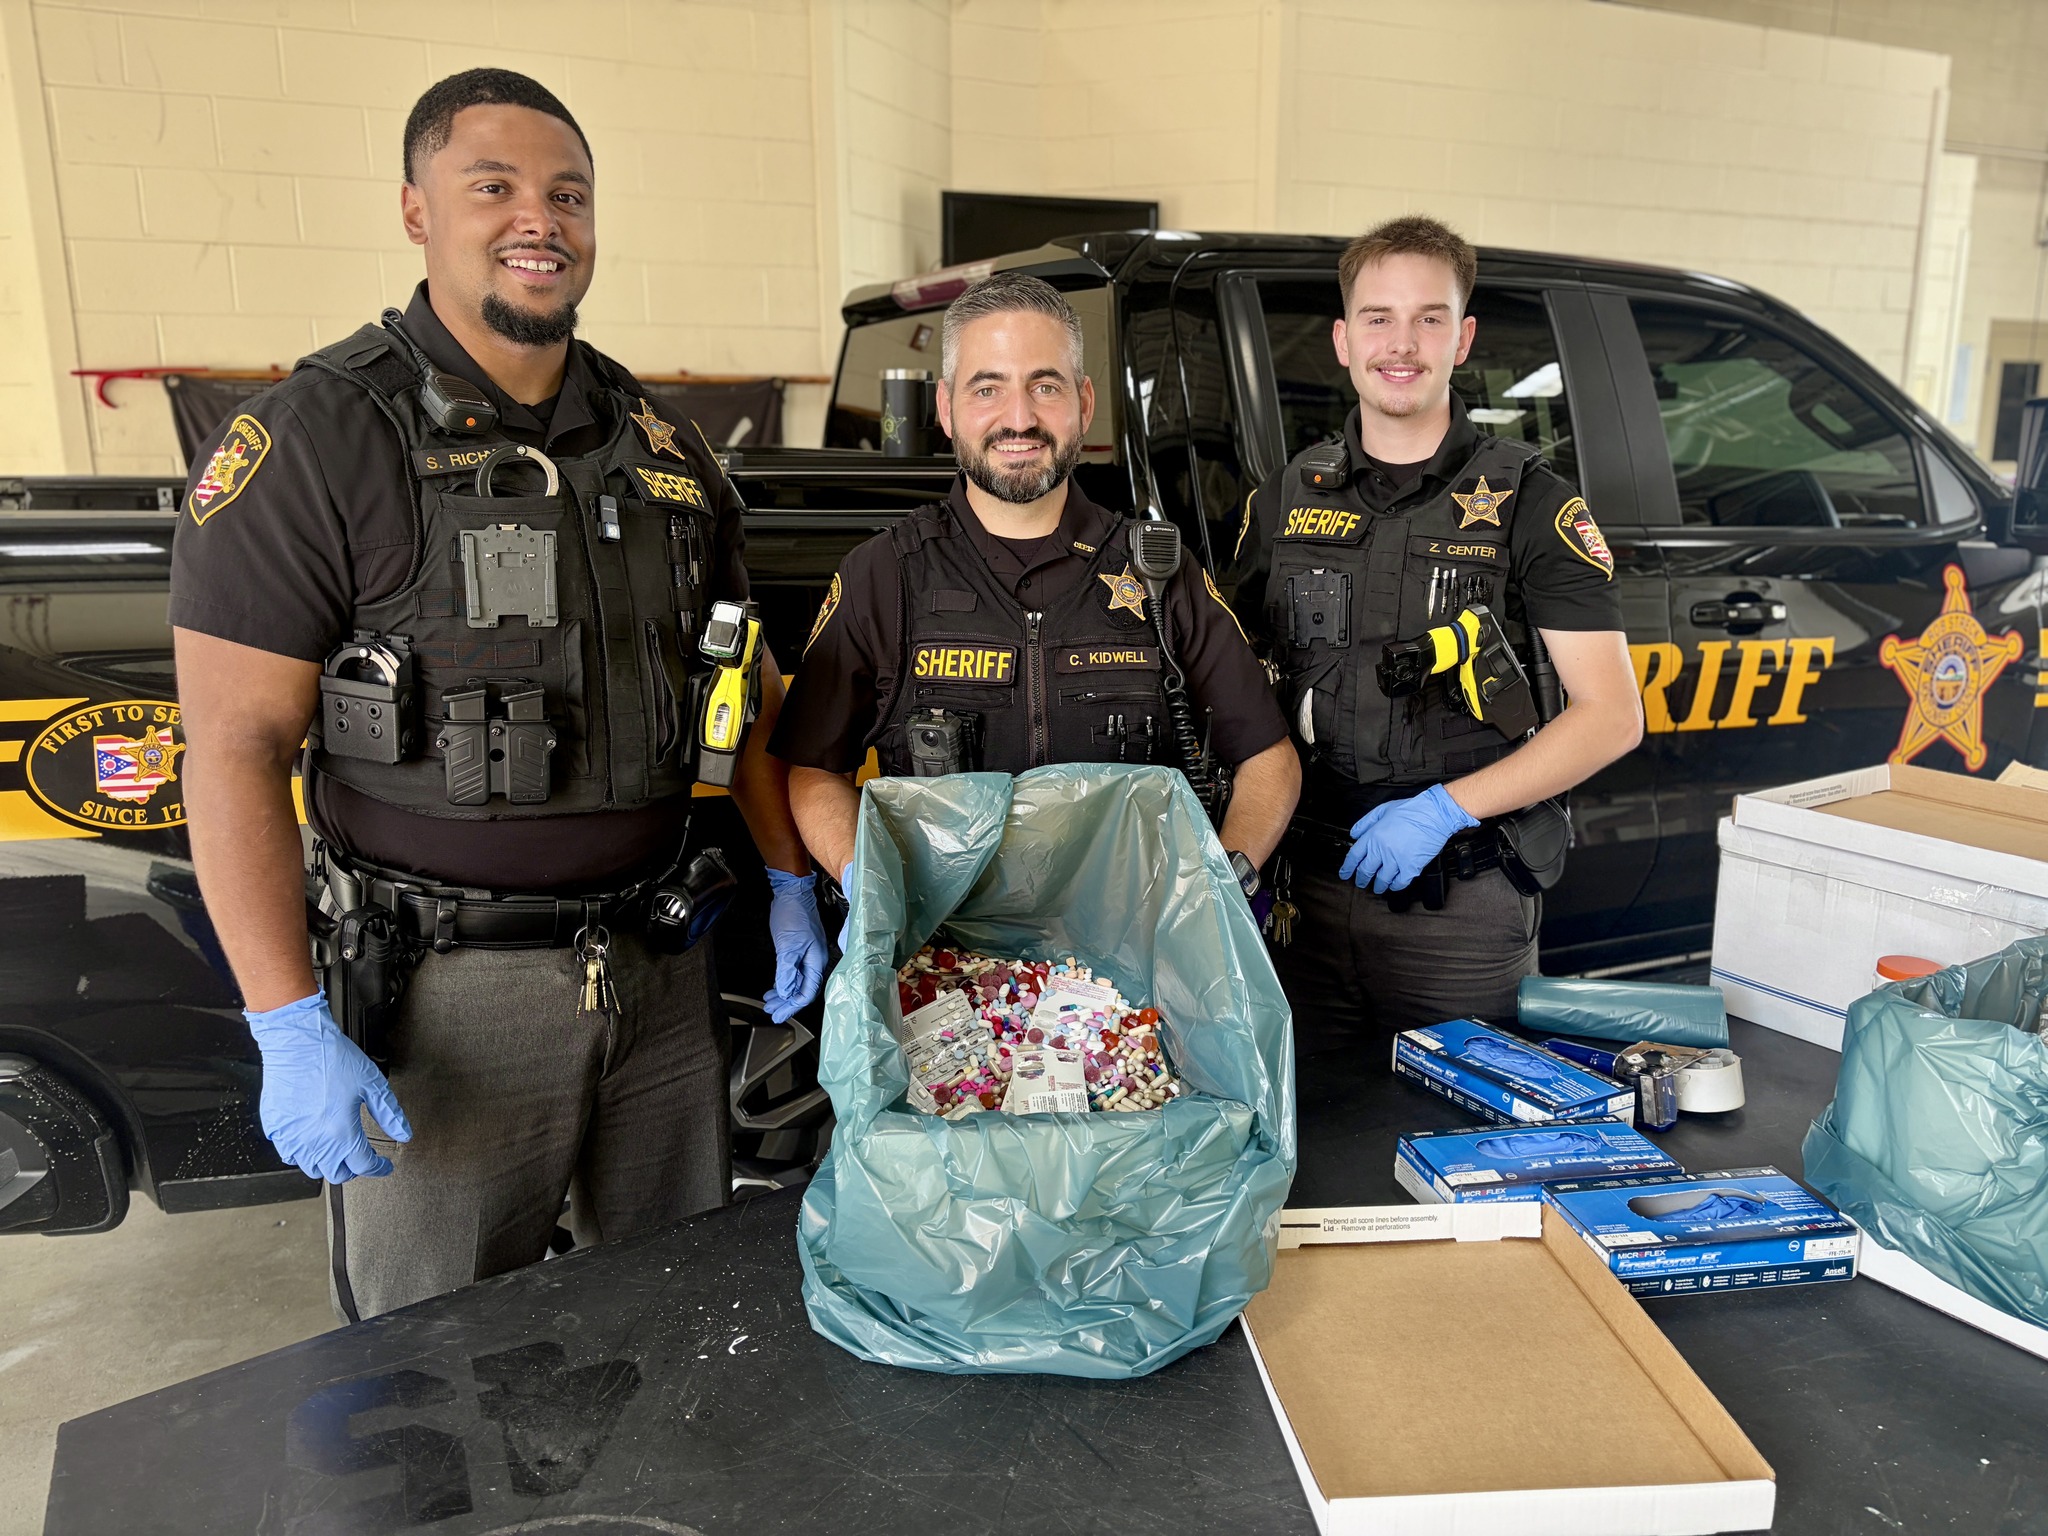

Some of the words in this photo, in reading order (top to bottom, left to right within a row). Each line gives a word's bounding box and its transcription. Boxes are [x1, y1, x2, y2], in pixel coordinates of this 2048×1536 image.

[237, 421, 263, 451] SHERIFF
[426, 456, 443, 470] S.
[450, 448, 497, 467] RICH
[637, 467, 705, 508] SHERIFF
[1284, 507, 1361, 537] SHERIFF
[1429, 542, 1440, 553] Z.
[1447, 545, 1496, 559] CENTER
[1069, 654, 1083, 666] C.
[1089, 651, 1148, 664] KIDWELL
[1923, 635, 1980, 674] SHERIFF
[914, 648, 1012, 679] SHERIFF
[1628, 636, 1836, 734] RIFF
[40, 710, 104, 754] FIRST
[112, 705, 144, 723] TO
[153, 706, 182, 726] SE
[79, 800, 148, 824] SINCE
[161, 803, 184, 822] 17
[1397, 1062, 1406, 1073] 50
[1608, 1161, 1675, 1171] MICROFLEX
[1461, 1188, 1508, 1198] MICROFLEX
[1375, 1223, 1411, 1231] perforations
[1410, 1215, 1438, 1223] assembly.
[1775, 1221, 1848, 1233] MICROFLEX
[1617, 1249, 1667, 1260] MICROFLEX
[1699, 1251, 1722, 1265] EC
[1824, 1266, 1847, 1275] Ansell
